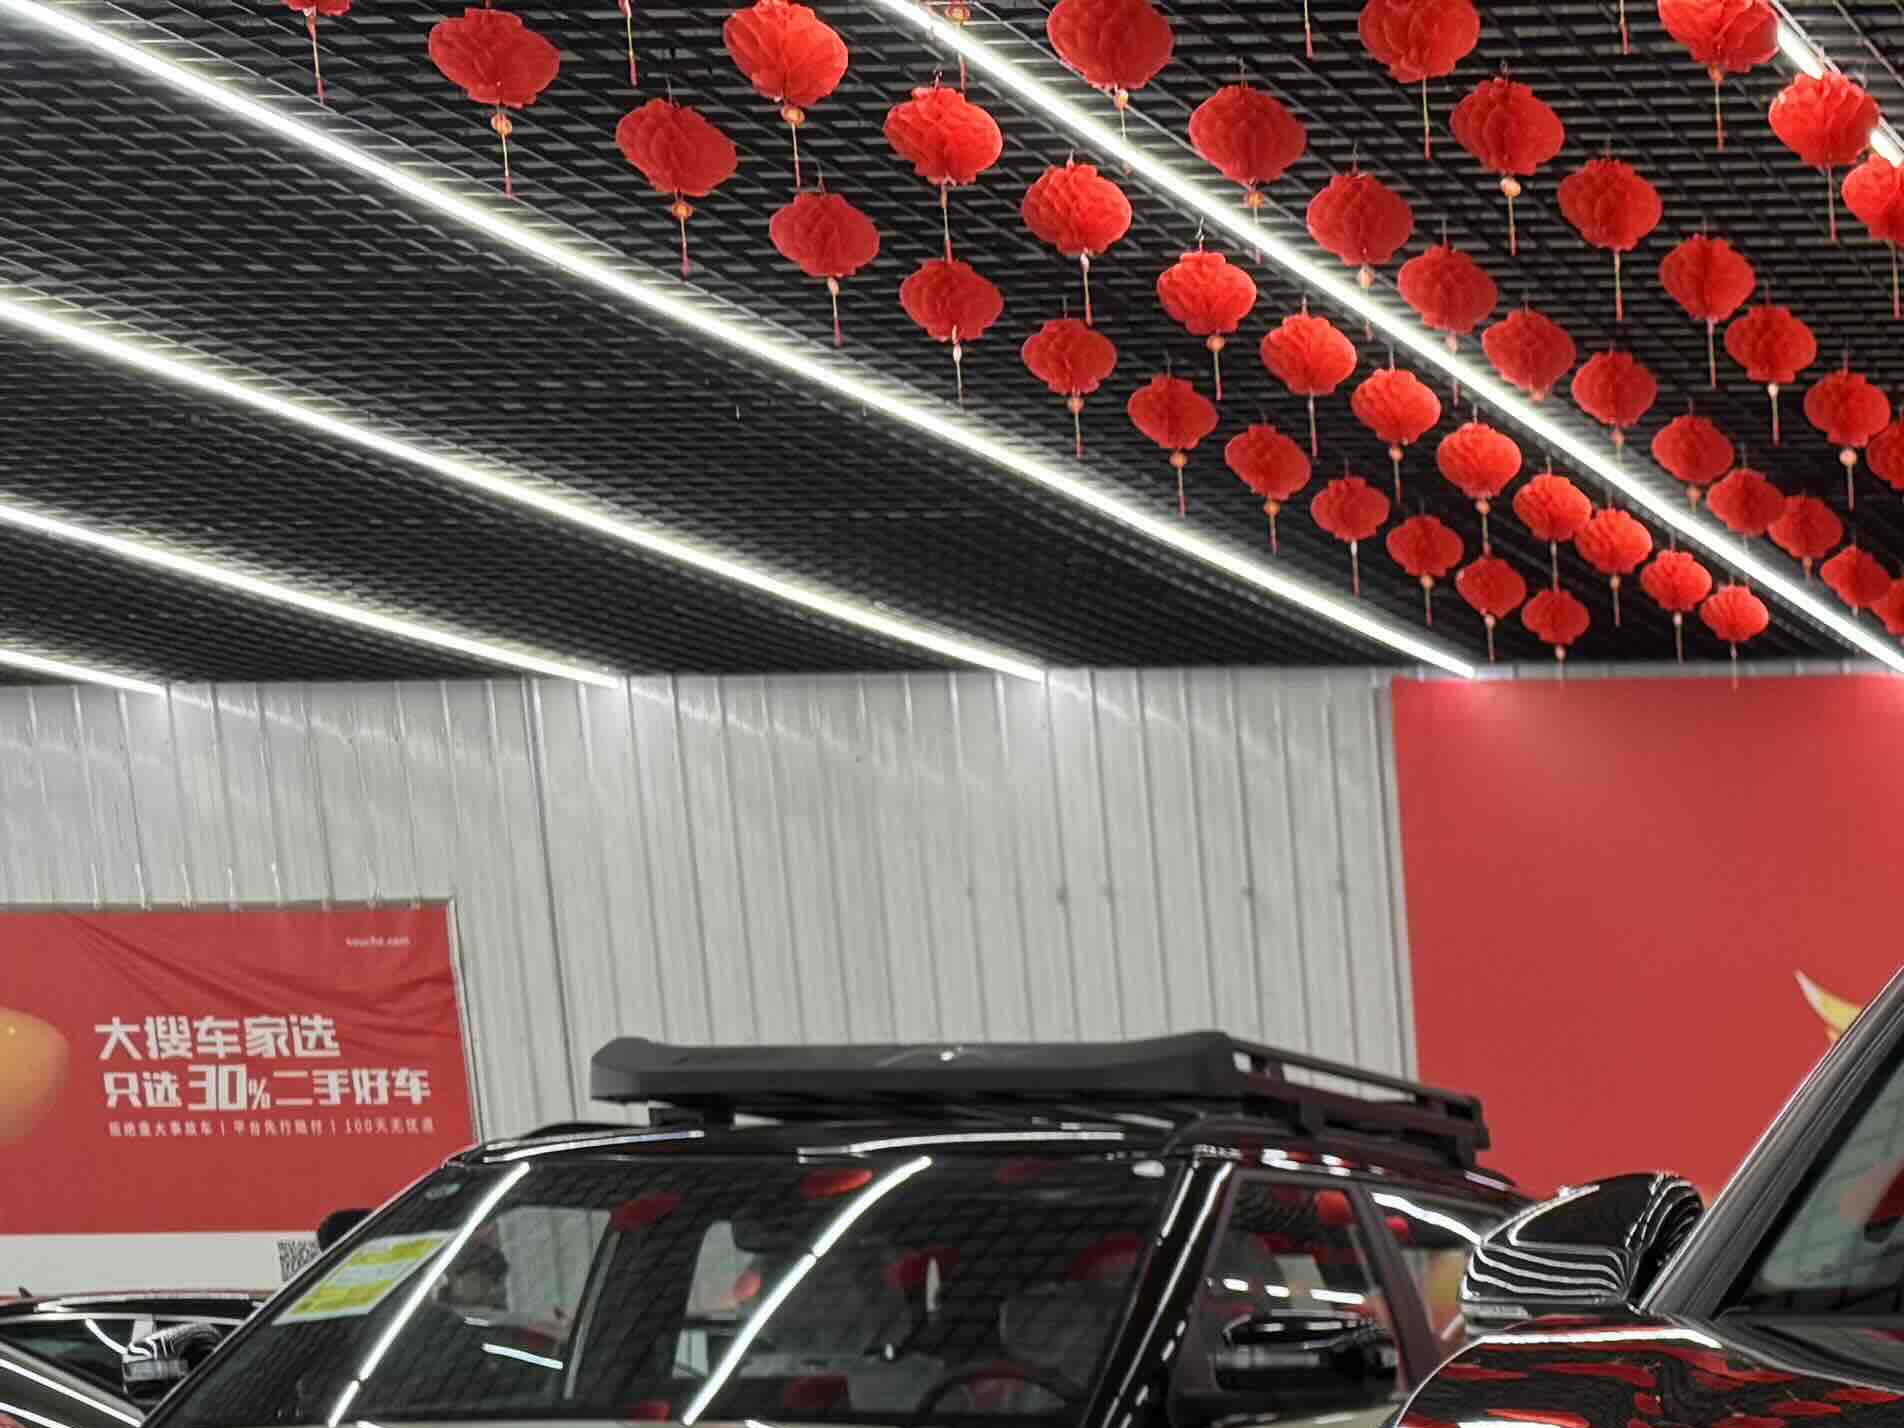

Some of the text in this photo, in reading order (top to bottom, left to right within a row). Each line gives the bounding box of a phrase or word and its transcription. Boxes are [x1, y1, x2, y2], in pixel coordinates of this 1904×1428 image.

[94, 1013, 341, 1060] 大搜车家选
[103, 1063, 432, 1111] 只选30%二手好车
